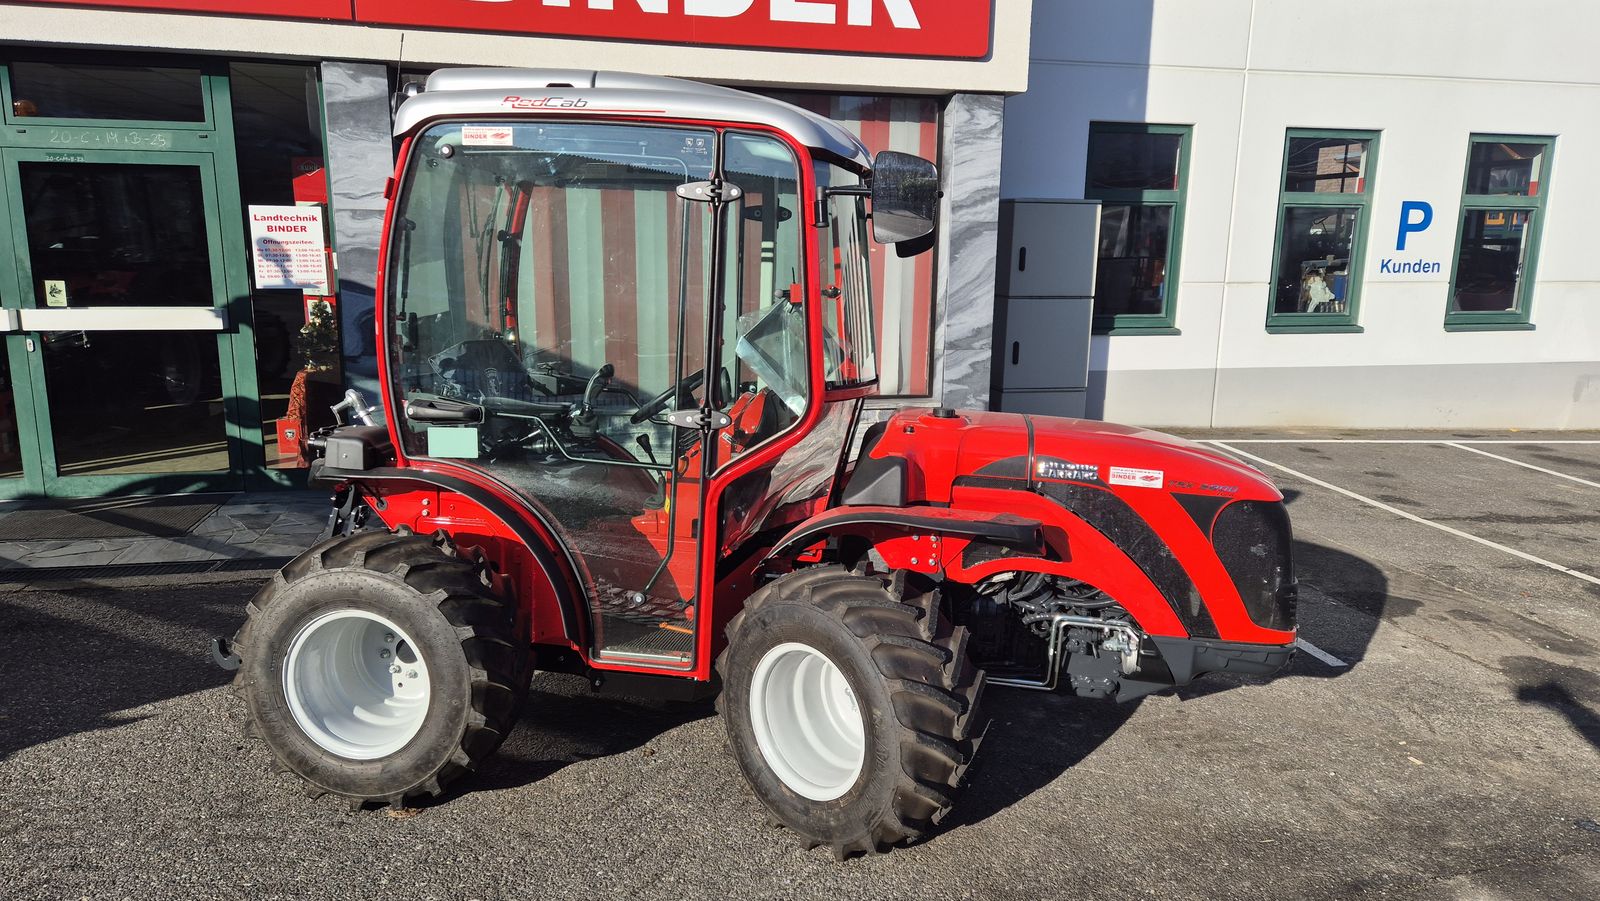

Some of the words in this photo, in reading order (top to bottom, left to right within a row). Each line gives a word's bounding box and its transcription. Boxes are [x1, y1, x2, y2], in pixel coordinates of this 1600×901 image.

[501, 95, 588, 109] RedCab
[253, 214, 318, 222] Landtechnik
[266, 225, 308, 233] BINDER
[1396, 201, 1433, 250] P
[1380, 259, 1441, 274] Kunden
[1112, 473, 1137, 481] BINDER
